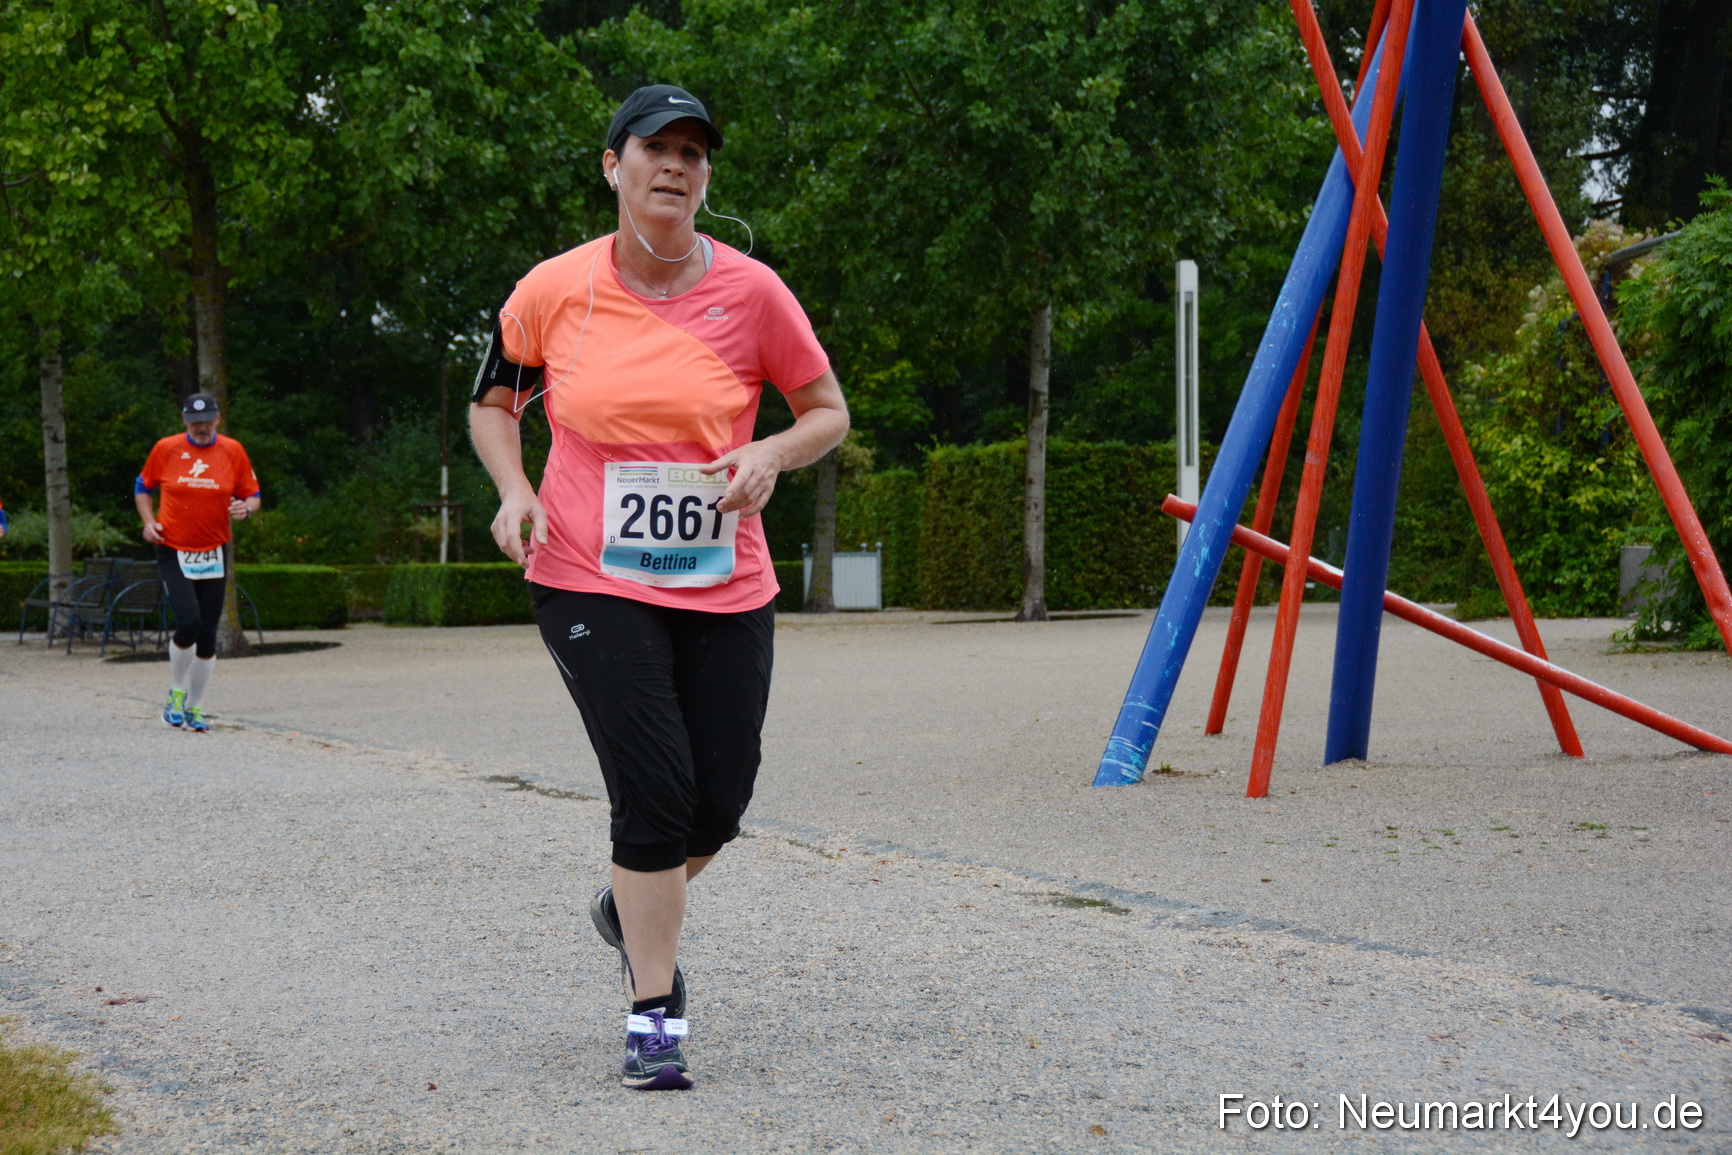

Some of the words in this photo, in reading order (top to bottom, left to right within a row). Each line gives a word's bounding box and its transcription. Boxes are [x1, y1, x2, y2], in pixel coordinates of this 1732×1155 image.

[620, 493, 724, 541] 2661
[610, 536, 616, 544] D
[640, 552, 697, 570] Bettina
